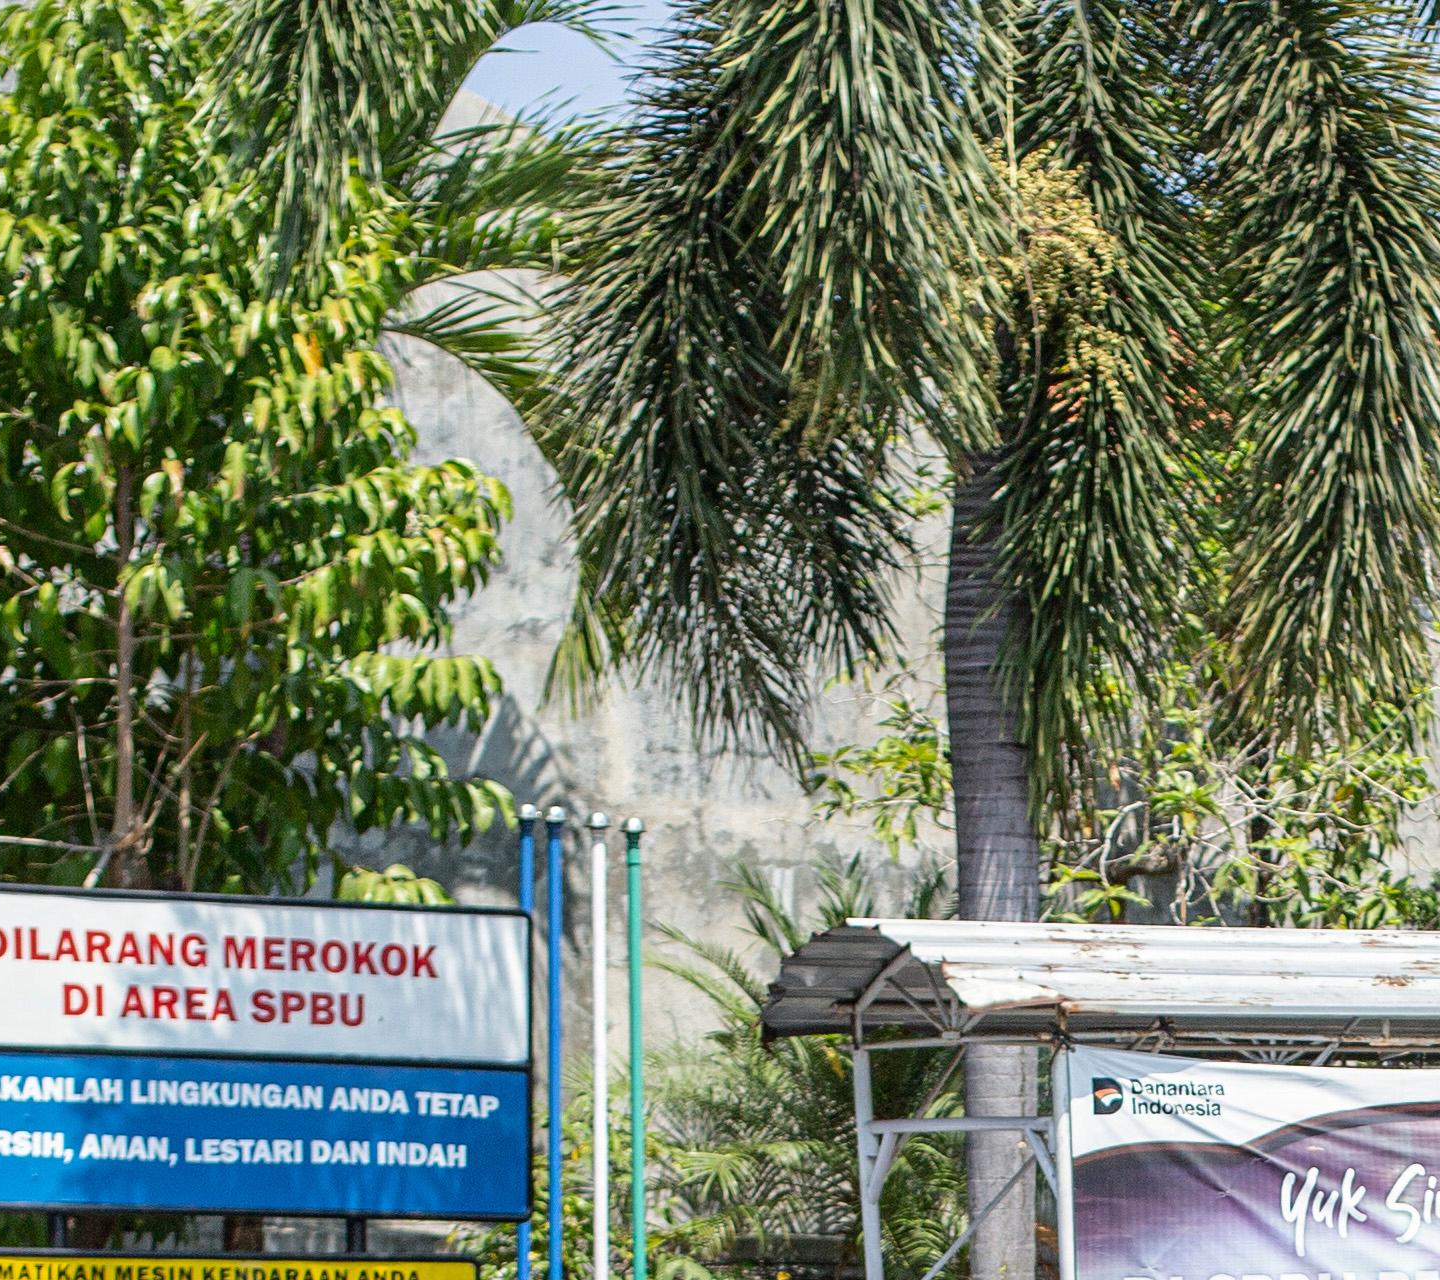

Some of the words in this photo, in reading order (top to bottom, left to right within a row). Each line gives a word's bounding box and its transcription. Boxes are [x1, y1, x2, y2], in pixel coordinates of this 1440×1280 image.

[224, 936, 439, 979] MEROKOK
[63, 984, 105, 1017] DI
[121, 986, 237, 1023] AREA
[251, 990, 366, 1027] SPBU
[131, 1079, 324, 1110] LINGKUNGAN
[330, 1087, 410, 1115] ANDA
[415, 1091, 500, 1119] TETAP
[1130, 1079, 1225, 1098] Danantara
[1132, 1097, 1222, 1117] Indonesia
[79, 1133, 178, 1167] AMAN,
[184, 1139, 303, 1165] LESTARI
[311, 1141, 370, 1166] DAN
[376, 1142, 467, 1167] INDAH
[1281, 1167, 1367, 1256] Yuk
